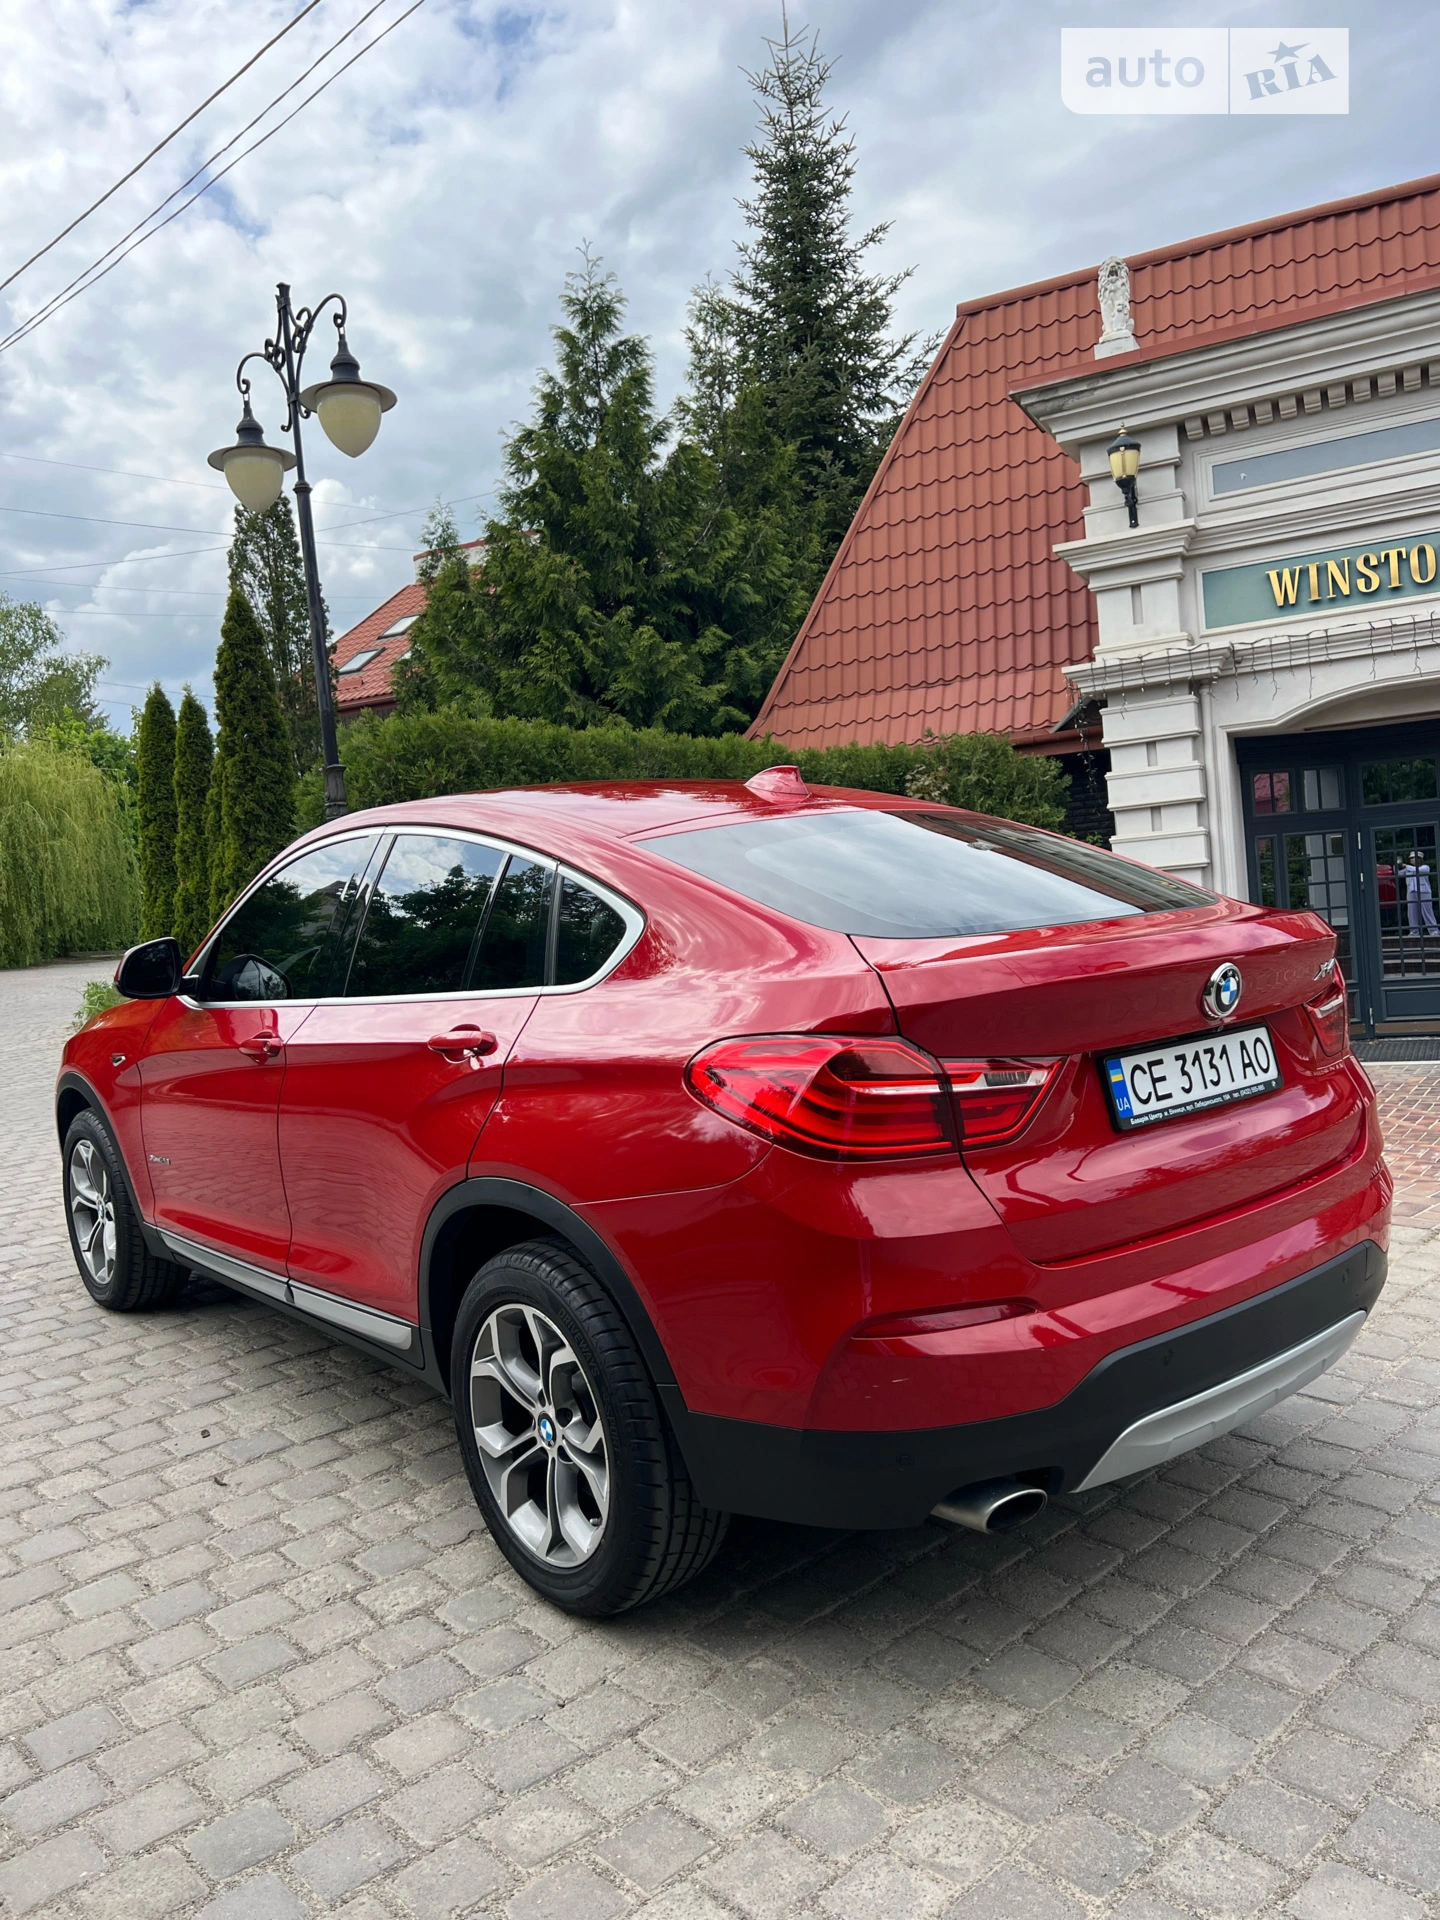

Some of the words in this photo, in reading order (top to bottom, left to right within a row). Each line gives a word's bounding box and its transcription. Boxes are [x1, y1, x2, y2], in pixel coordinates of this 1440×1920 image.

[1265, 543, 1437, 607] WINSTO
[1116, 1096, 1131, 1111] UA
[1130, 1058, 1173, 1105] CE
[1174, 1044, 1235, 1094] 3131
[1239, 1036, 1270, 1080] AO
[557, 1308, 600, 1377] DRIVEWAYS
